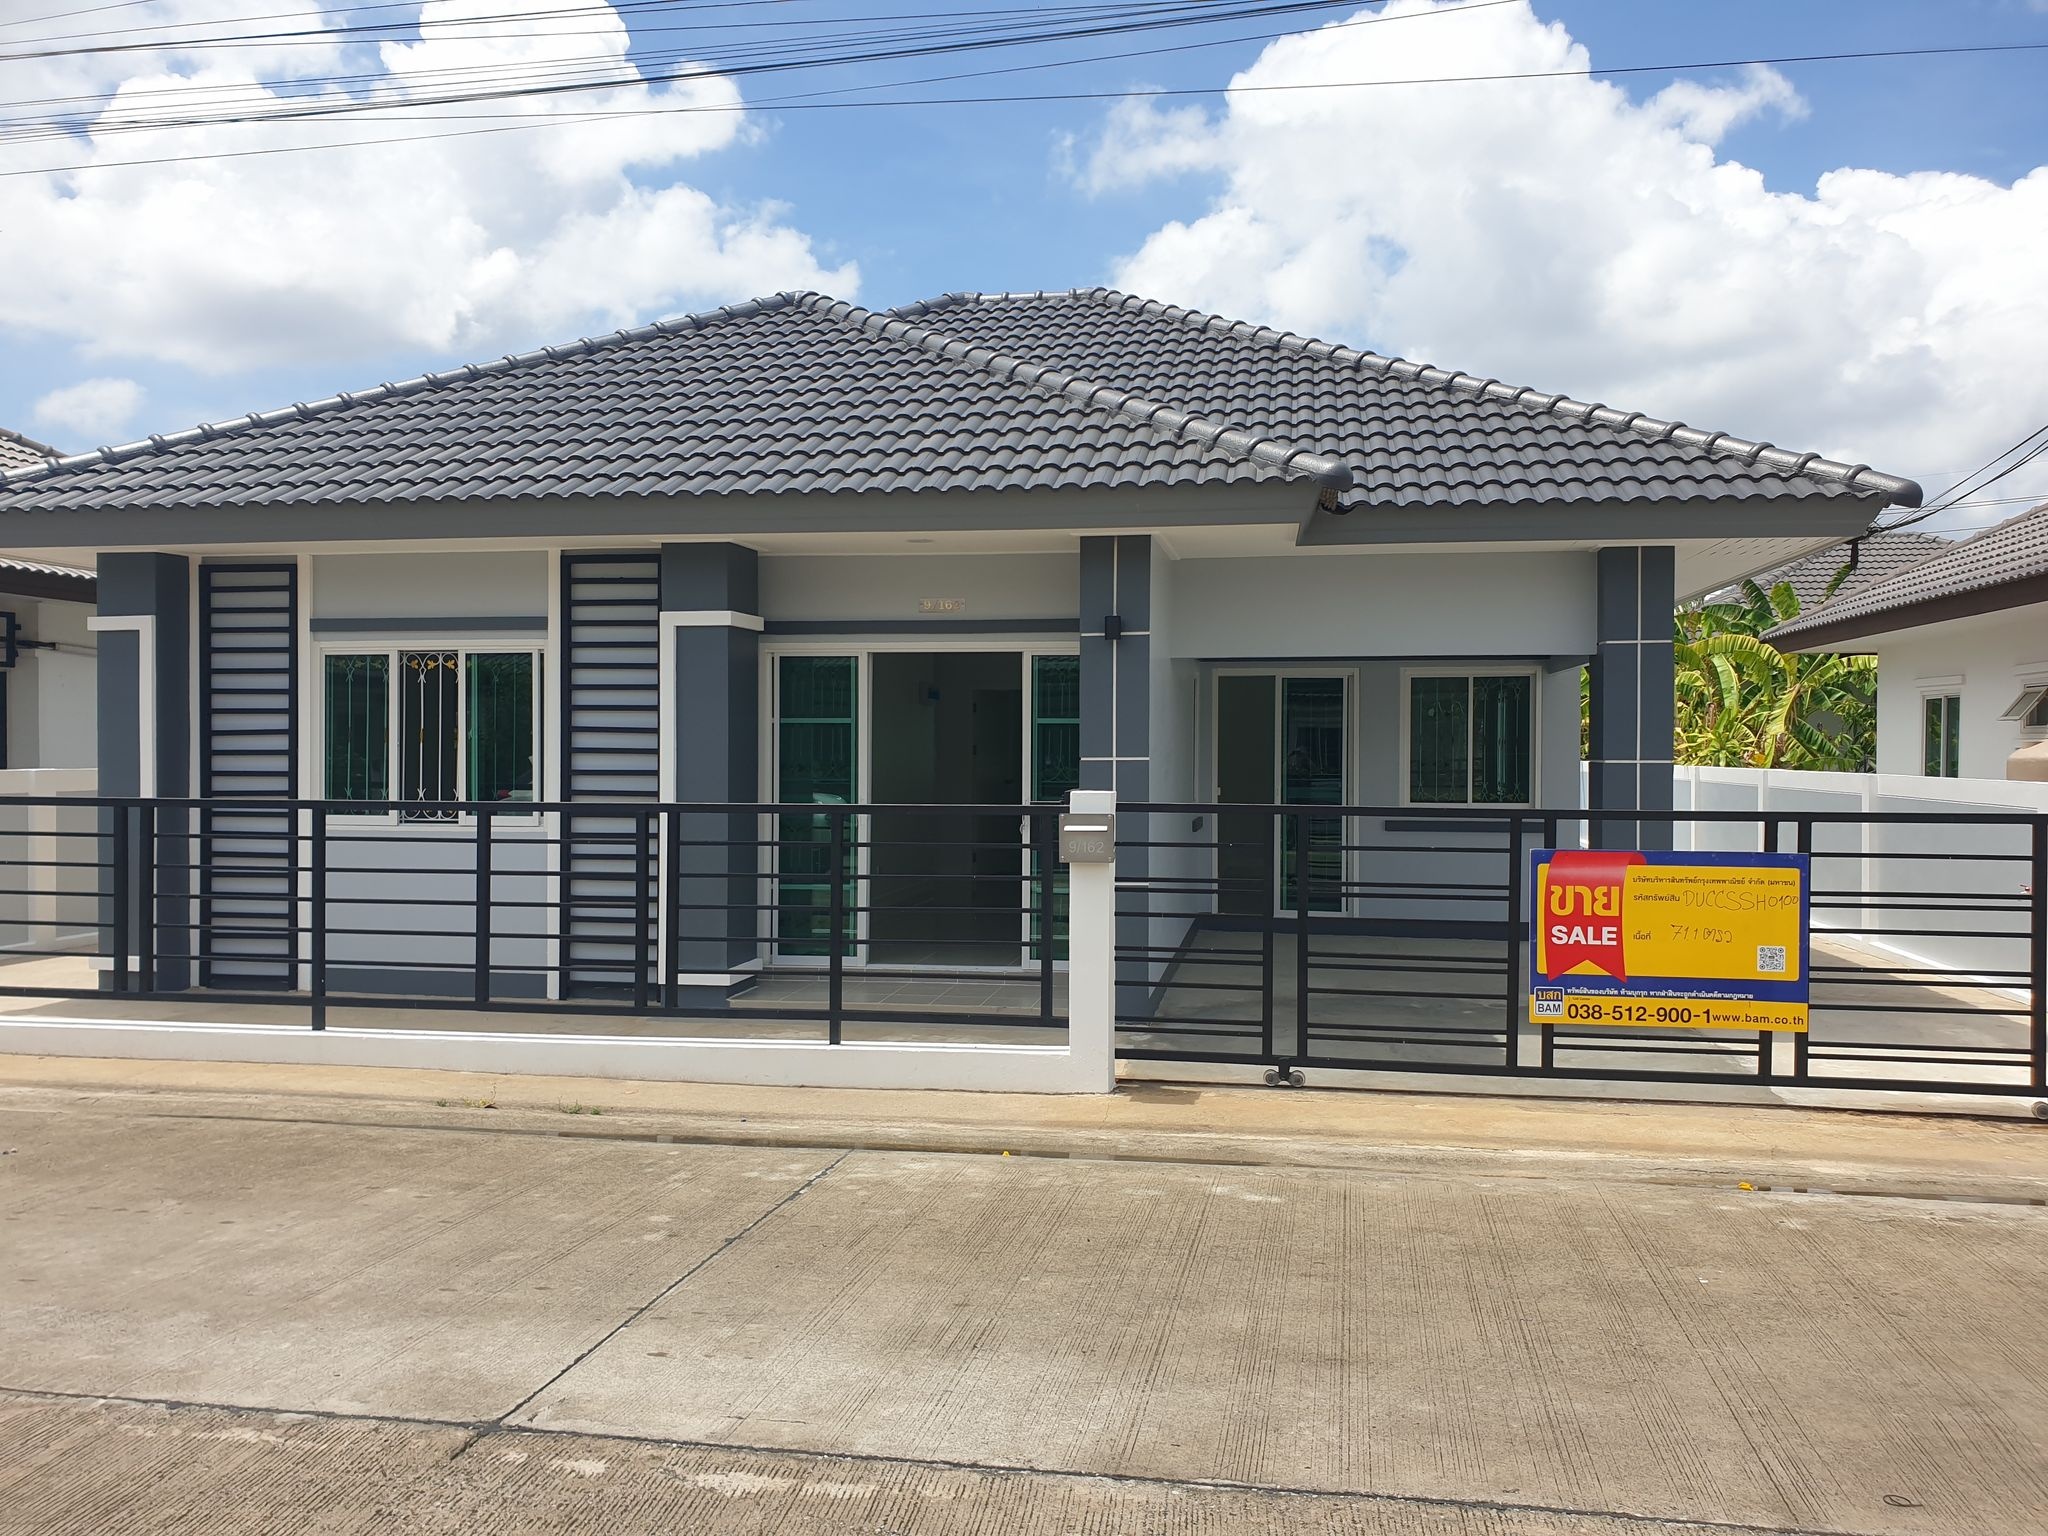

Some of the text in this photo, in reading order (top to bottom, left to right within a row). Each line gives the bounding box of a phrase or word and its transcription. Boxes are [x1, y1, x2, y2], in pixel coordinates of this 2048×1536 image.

[1068, 840, 1105, 854] 9/162
[1748, 877, 1765, 886] จำกัด
[1767, 878, 1796, 887] (มหาชน)
[1550, 885, 1620, 917] ขาย
[1633, 892, 1681, 903] รหัสทรัพย์สิน
[1551, 925, 1618, 946] SALE
[1633, 931, 1652, 942] เนื้อที่
[1537, 989, 1562, 1000] บสก
[1537, 1003, 1562, 1014] BAM
[1567, 1003, 1805, 1026] 038-512-900-1 www.bam.co.th
